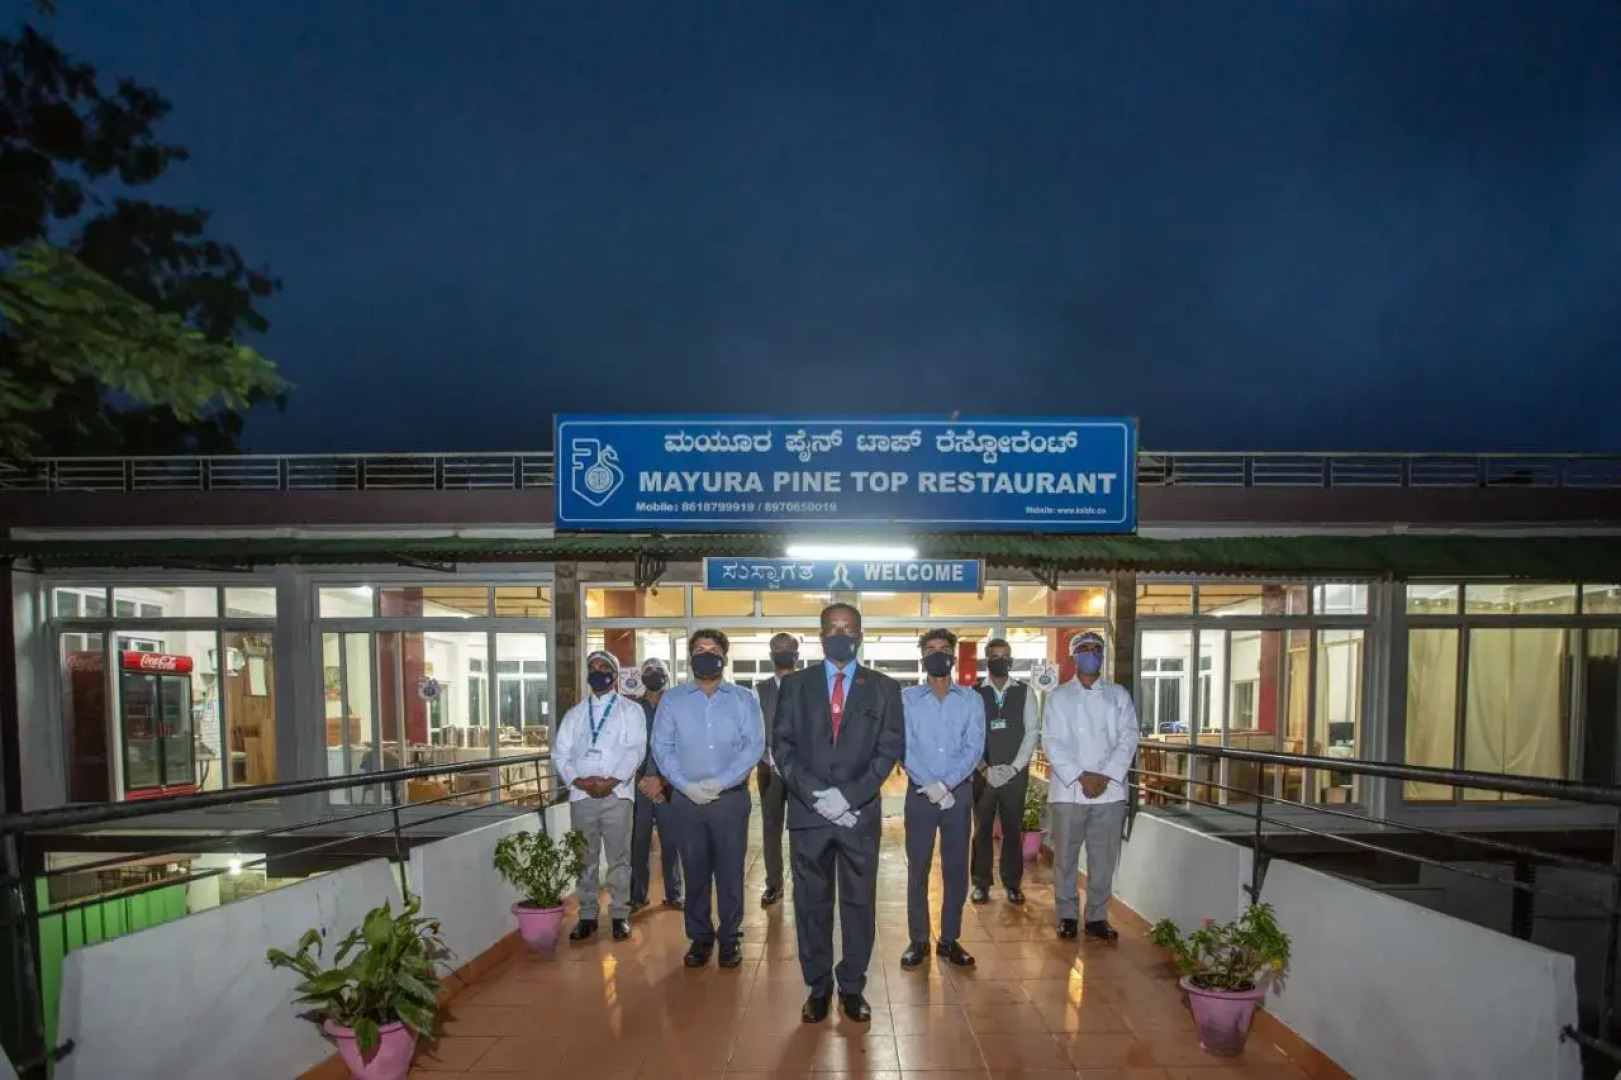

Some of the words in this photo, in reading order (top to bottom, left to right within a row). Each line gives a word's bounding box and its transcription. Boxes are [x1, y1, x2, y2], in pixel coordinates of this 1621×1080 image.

[663, 429, 772, 453] ಮಯೂರ
[856, 429, 923, 453] ಟಾಪ್
[638, 471, 764, 493] MAYURA
[773, 471, 842, 493] PINE
[850, 471, 909, 493] TOP
[917, 471, 1118, 495] RESTAURANT
[636, 501, 679, 513] Mobile:
[863, 564, 964, 581] WELCOME
